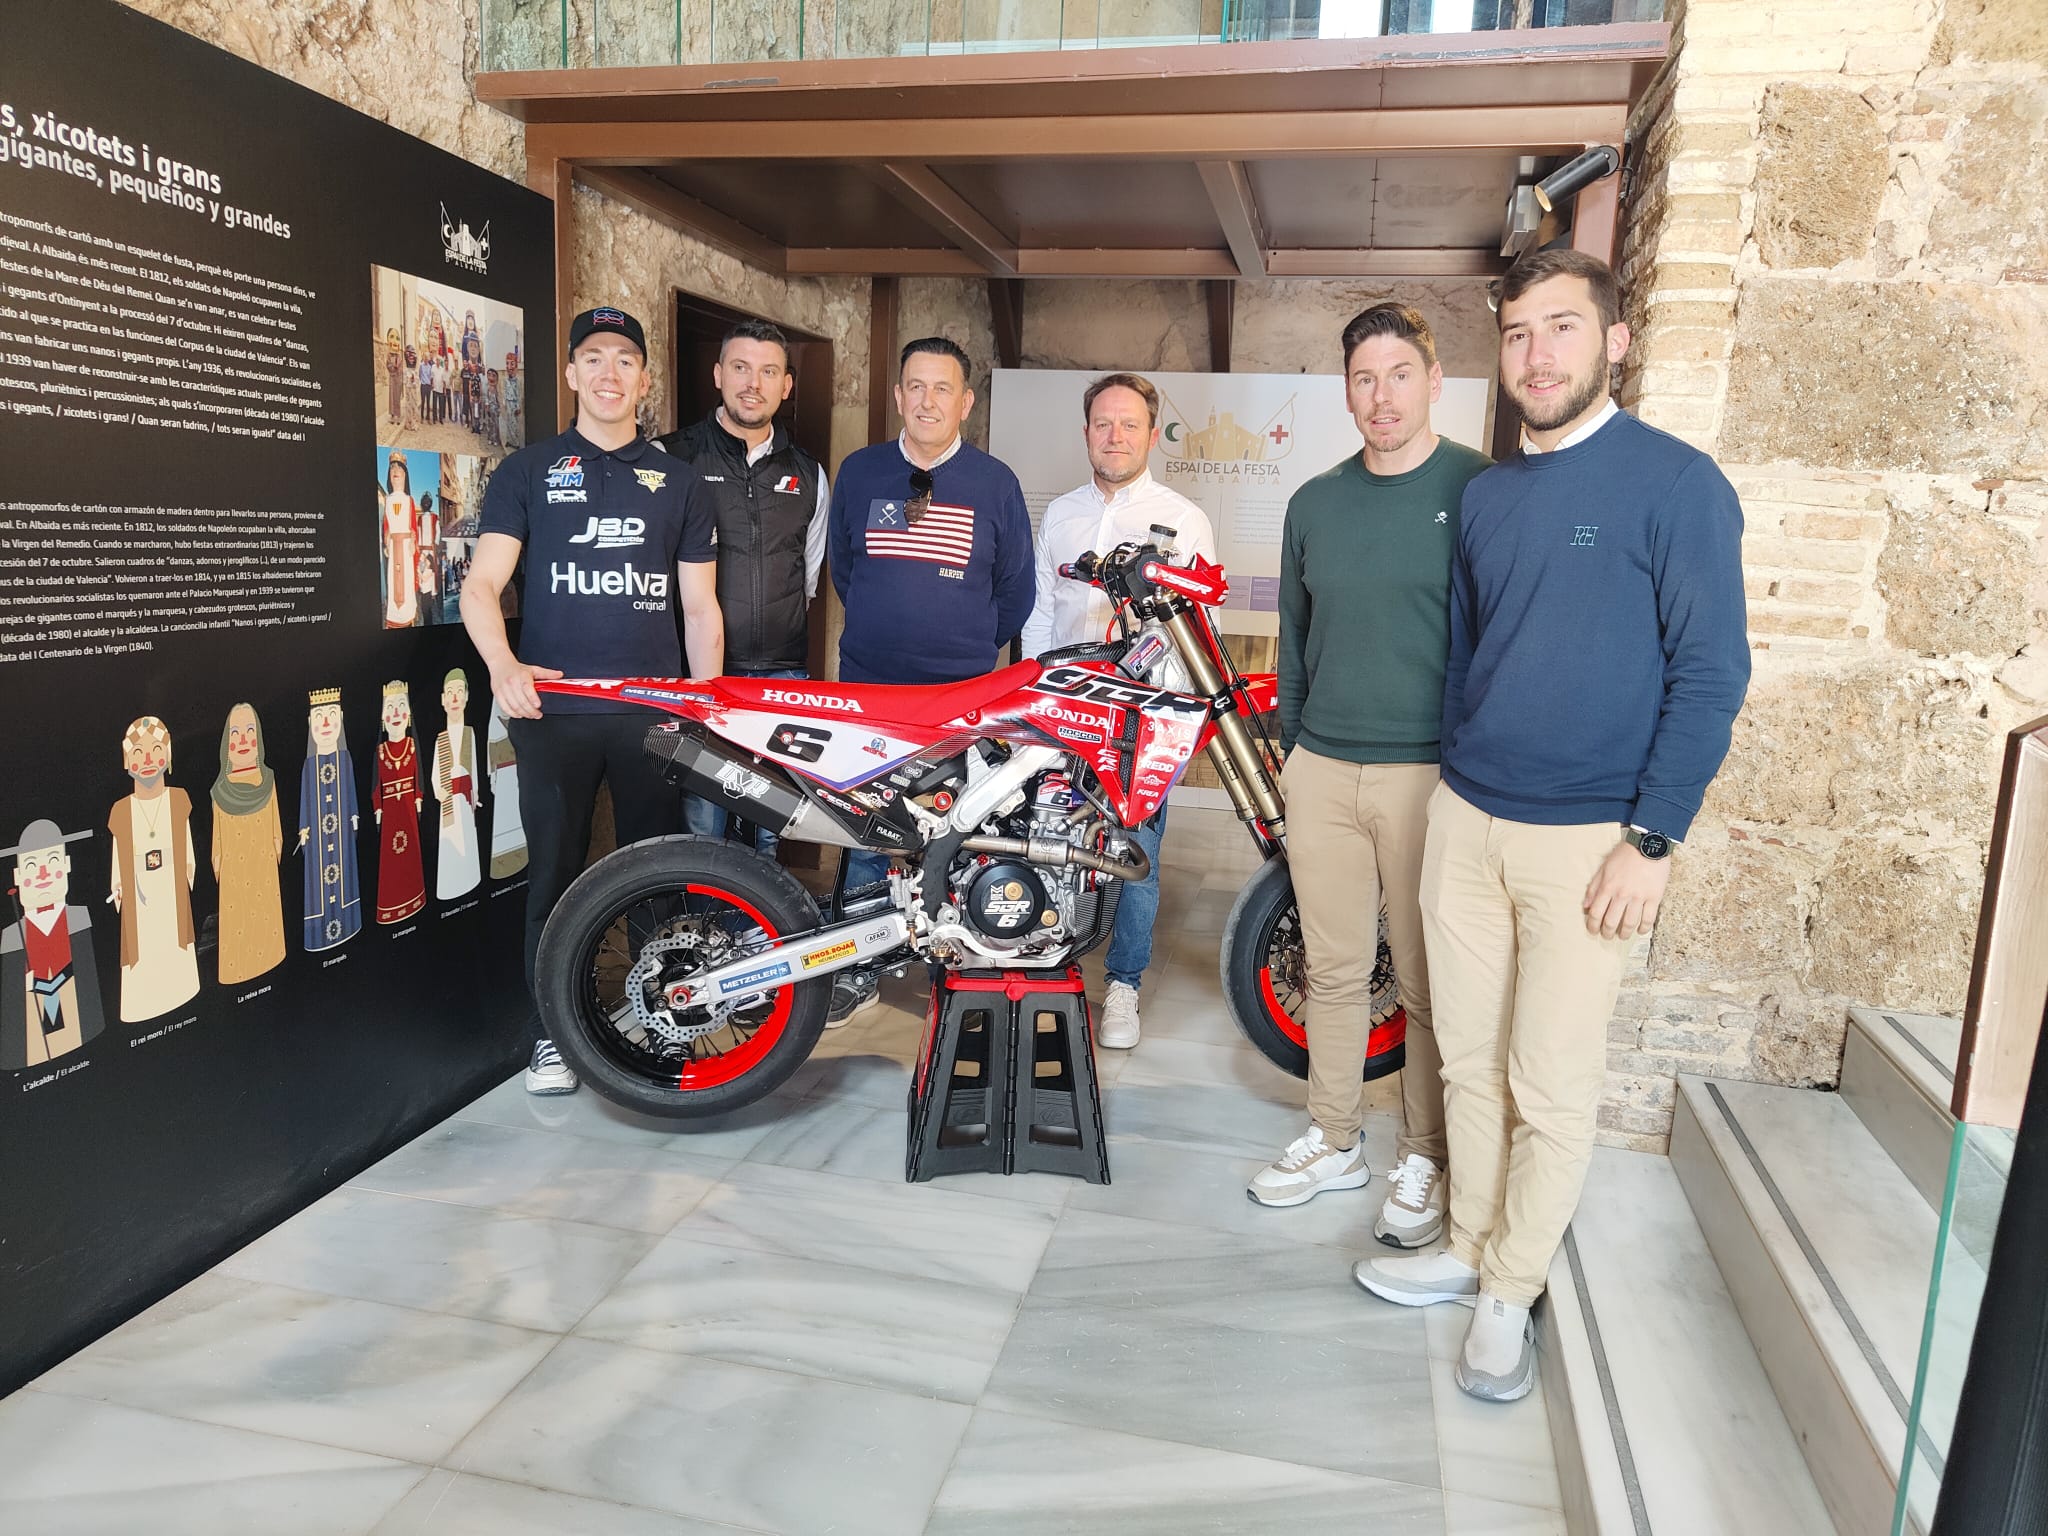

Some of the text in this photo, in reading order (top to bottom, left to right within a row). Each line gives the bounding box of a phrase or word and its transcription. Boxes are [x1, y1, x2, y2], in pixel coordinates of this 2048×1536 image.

[31, 111, 136, 168] xicotets
[142, 144, 150, 172] i
[157, 155, 222, 194] grans
[109, 168, 205, 214] pequeños
[209, 200, 220, 222] y
[224, 204, 291, 239] grandes
[41, 244, 76, 261] Albaida
[67, 230, 92, 243] cartó
[127, 245, 161, 260] esquelet
[55, 270, 78, 284] Mare
[7, 285, 47, 300] gegants
[30, 313, 49, 324] que
[62, 319, 98, 332] practica
[125, 328, 163, 344] funciones
[13, 333, 32, 343] van
[34, 334, 70, 349] fabricar
[89, 346, 115, 357] nanos
[121, 351, 154, 363] gegants
[5, 353, 31, 366] 1939
[32, 359, 50, 369] van
[52, 360, 77, 372] haver
[92, 368, 148, 383] reconstruir-se
[40, 381, 87, 396] pluriètnics
[12, 402, 54, 416] gegants,
[63, 406, 97, 419] xicotets
[1166, 461, 1280, 476] ESPAI DE LA FESTA
[7, 502, 69, 512] antropomorfos
[28, 520, 60, 529] Albaida
[568, 517, 646, 544] JBD
[11, 538, 39, 550] Virgen
[35, 576, 62, 585] ciudad
[551, 562, 668, 597] Huelva
[939, 567, 964, 580] HARPER
[12, 594, 74, 604] revolucionarios
[633, 600, 666, 612] original
[37, 612, 72, 624] gigantes
[18, 650, 32, 660] del
[38, 647, 82, 658] Centenario
[624, 688, 696, 702] METZELER
[761, 688, 864, 713] HONDA
[1029, 703, 1110, 729] HONDA
[1059, 727, 1101, 741] ROCCOS
[766, 723, 832, 763] 6
[876, 826, 902, 843] FULBAT
[984, 900, 1031, 914] SGR
[997, 915, 1020, 927] 6
[868, 931, 887, 941] AFAM
[721, 968, 778, 990] METZELER
[237, 985, 272, 1003] La reina mora
[130, 1040, 137, 1048] El
[138, 1035, 146, 1045] rei
[147, 1029, 163, 1041] moro
[174, 1022, 183, 1031] rey
[183, 1016, 197, 1027] moro
[23, 1060, 90, 1092] L'alcalde El alcalde
